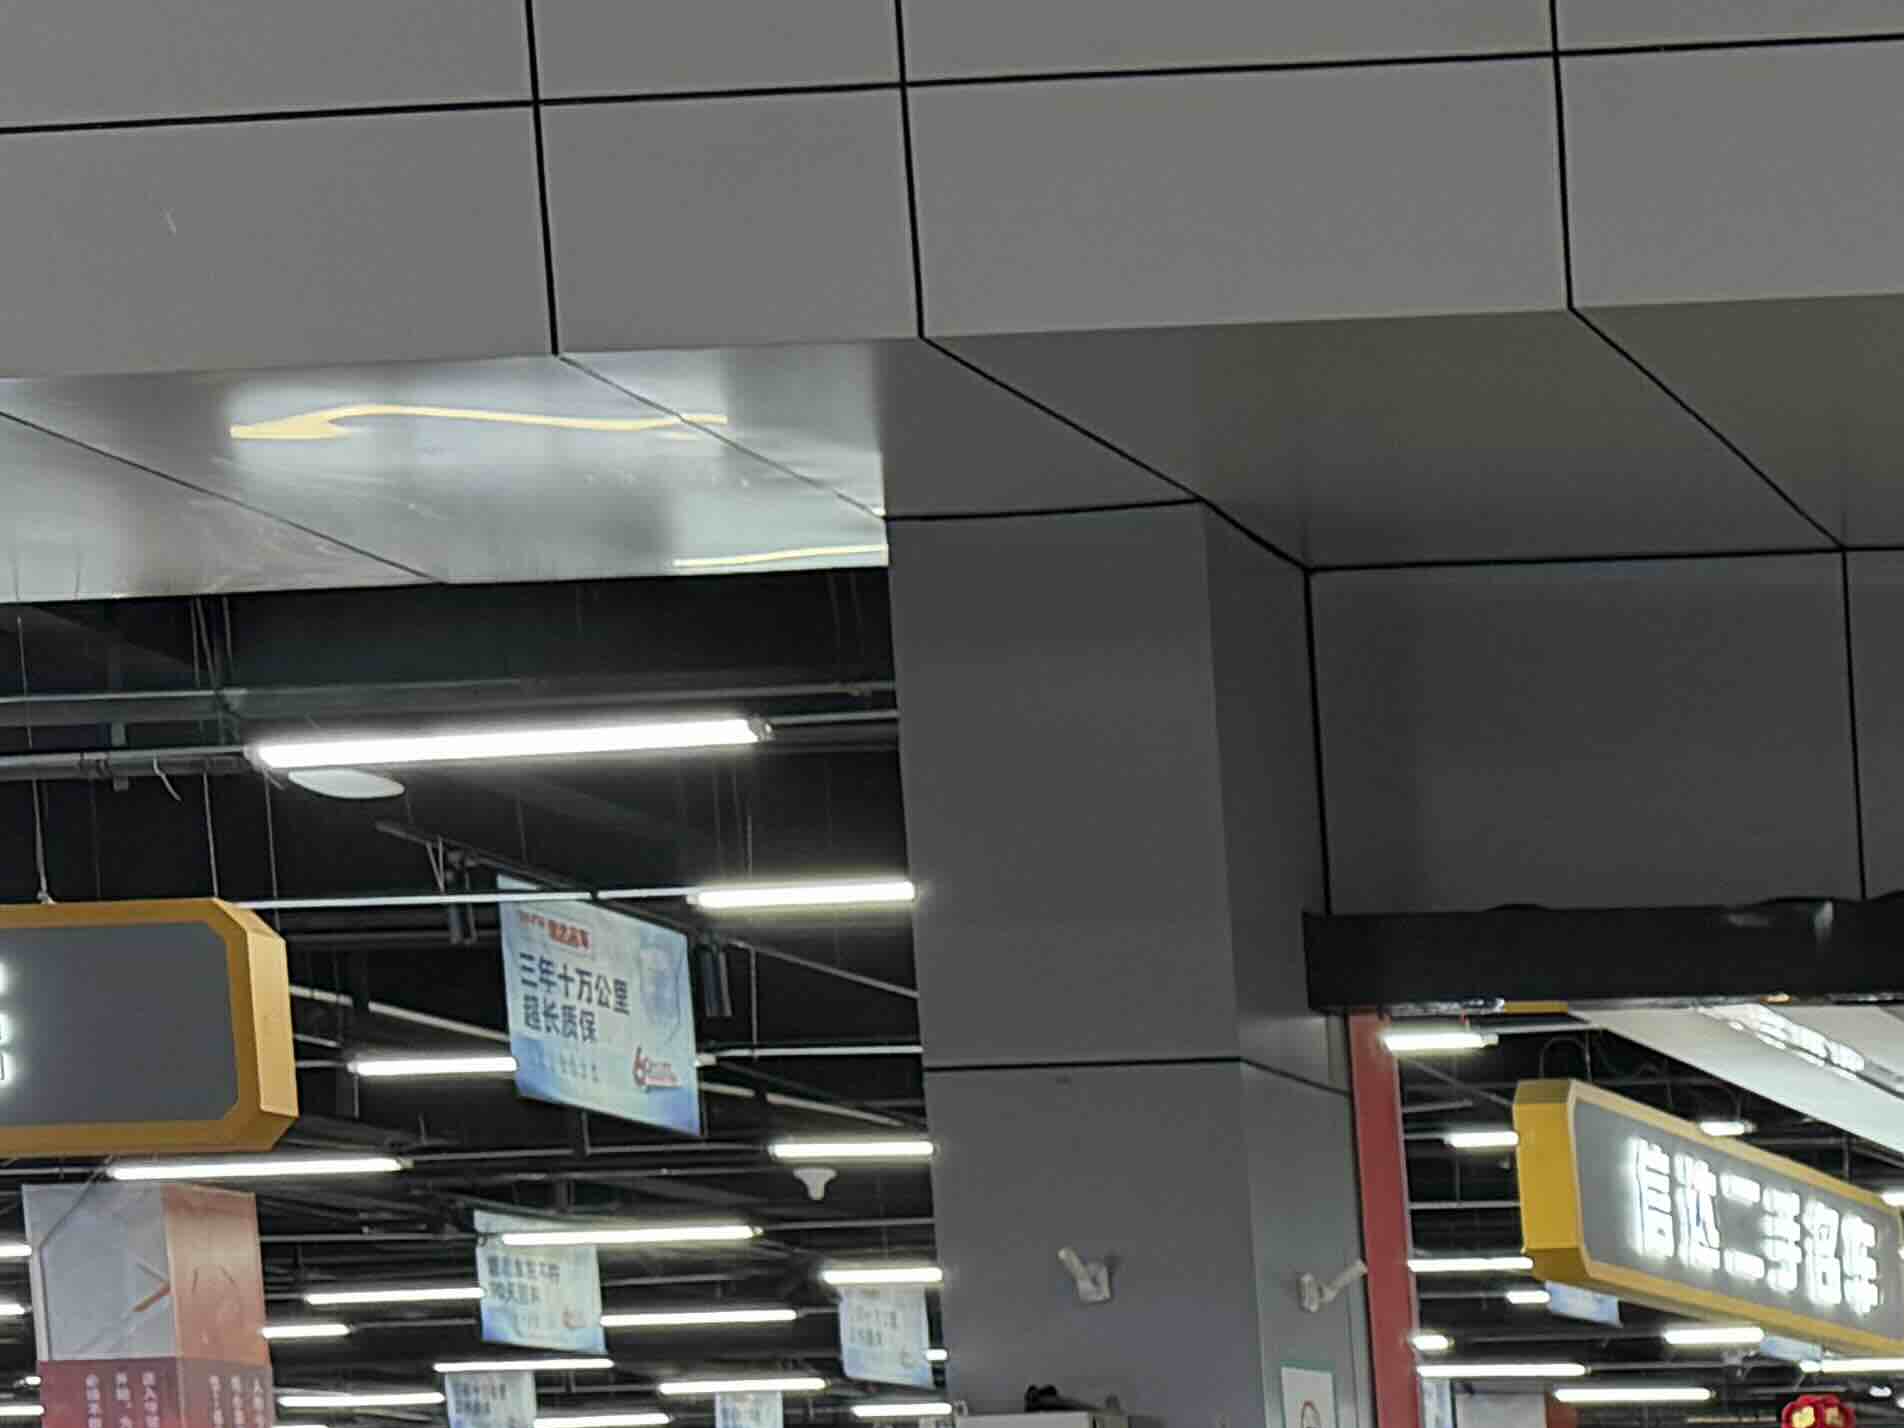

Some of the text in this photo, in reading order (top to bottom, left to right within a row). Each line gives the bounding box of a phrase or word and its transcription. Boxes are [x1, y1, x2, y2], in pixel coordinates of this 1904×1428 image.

[520, 953, 631, 1017] 三年十万公里
